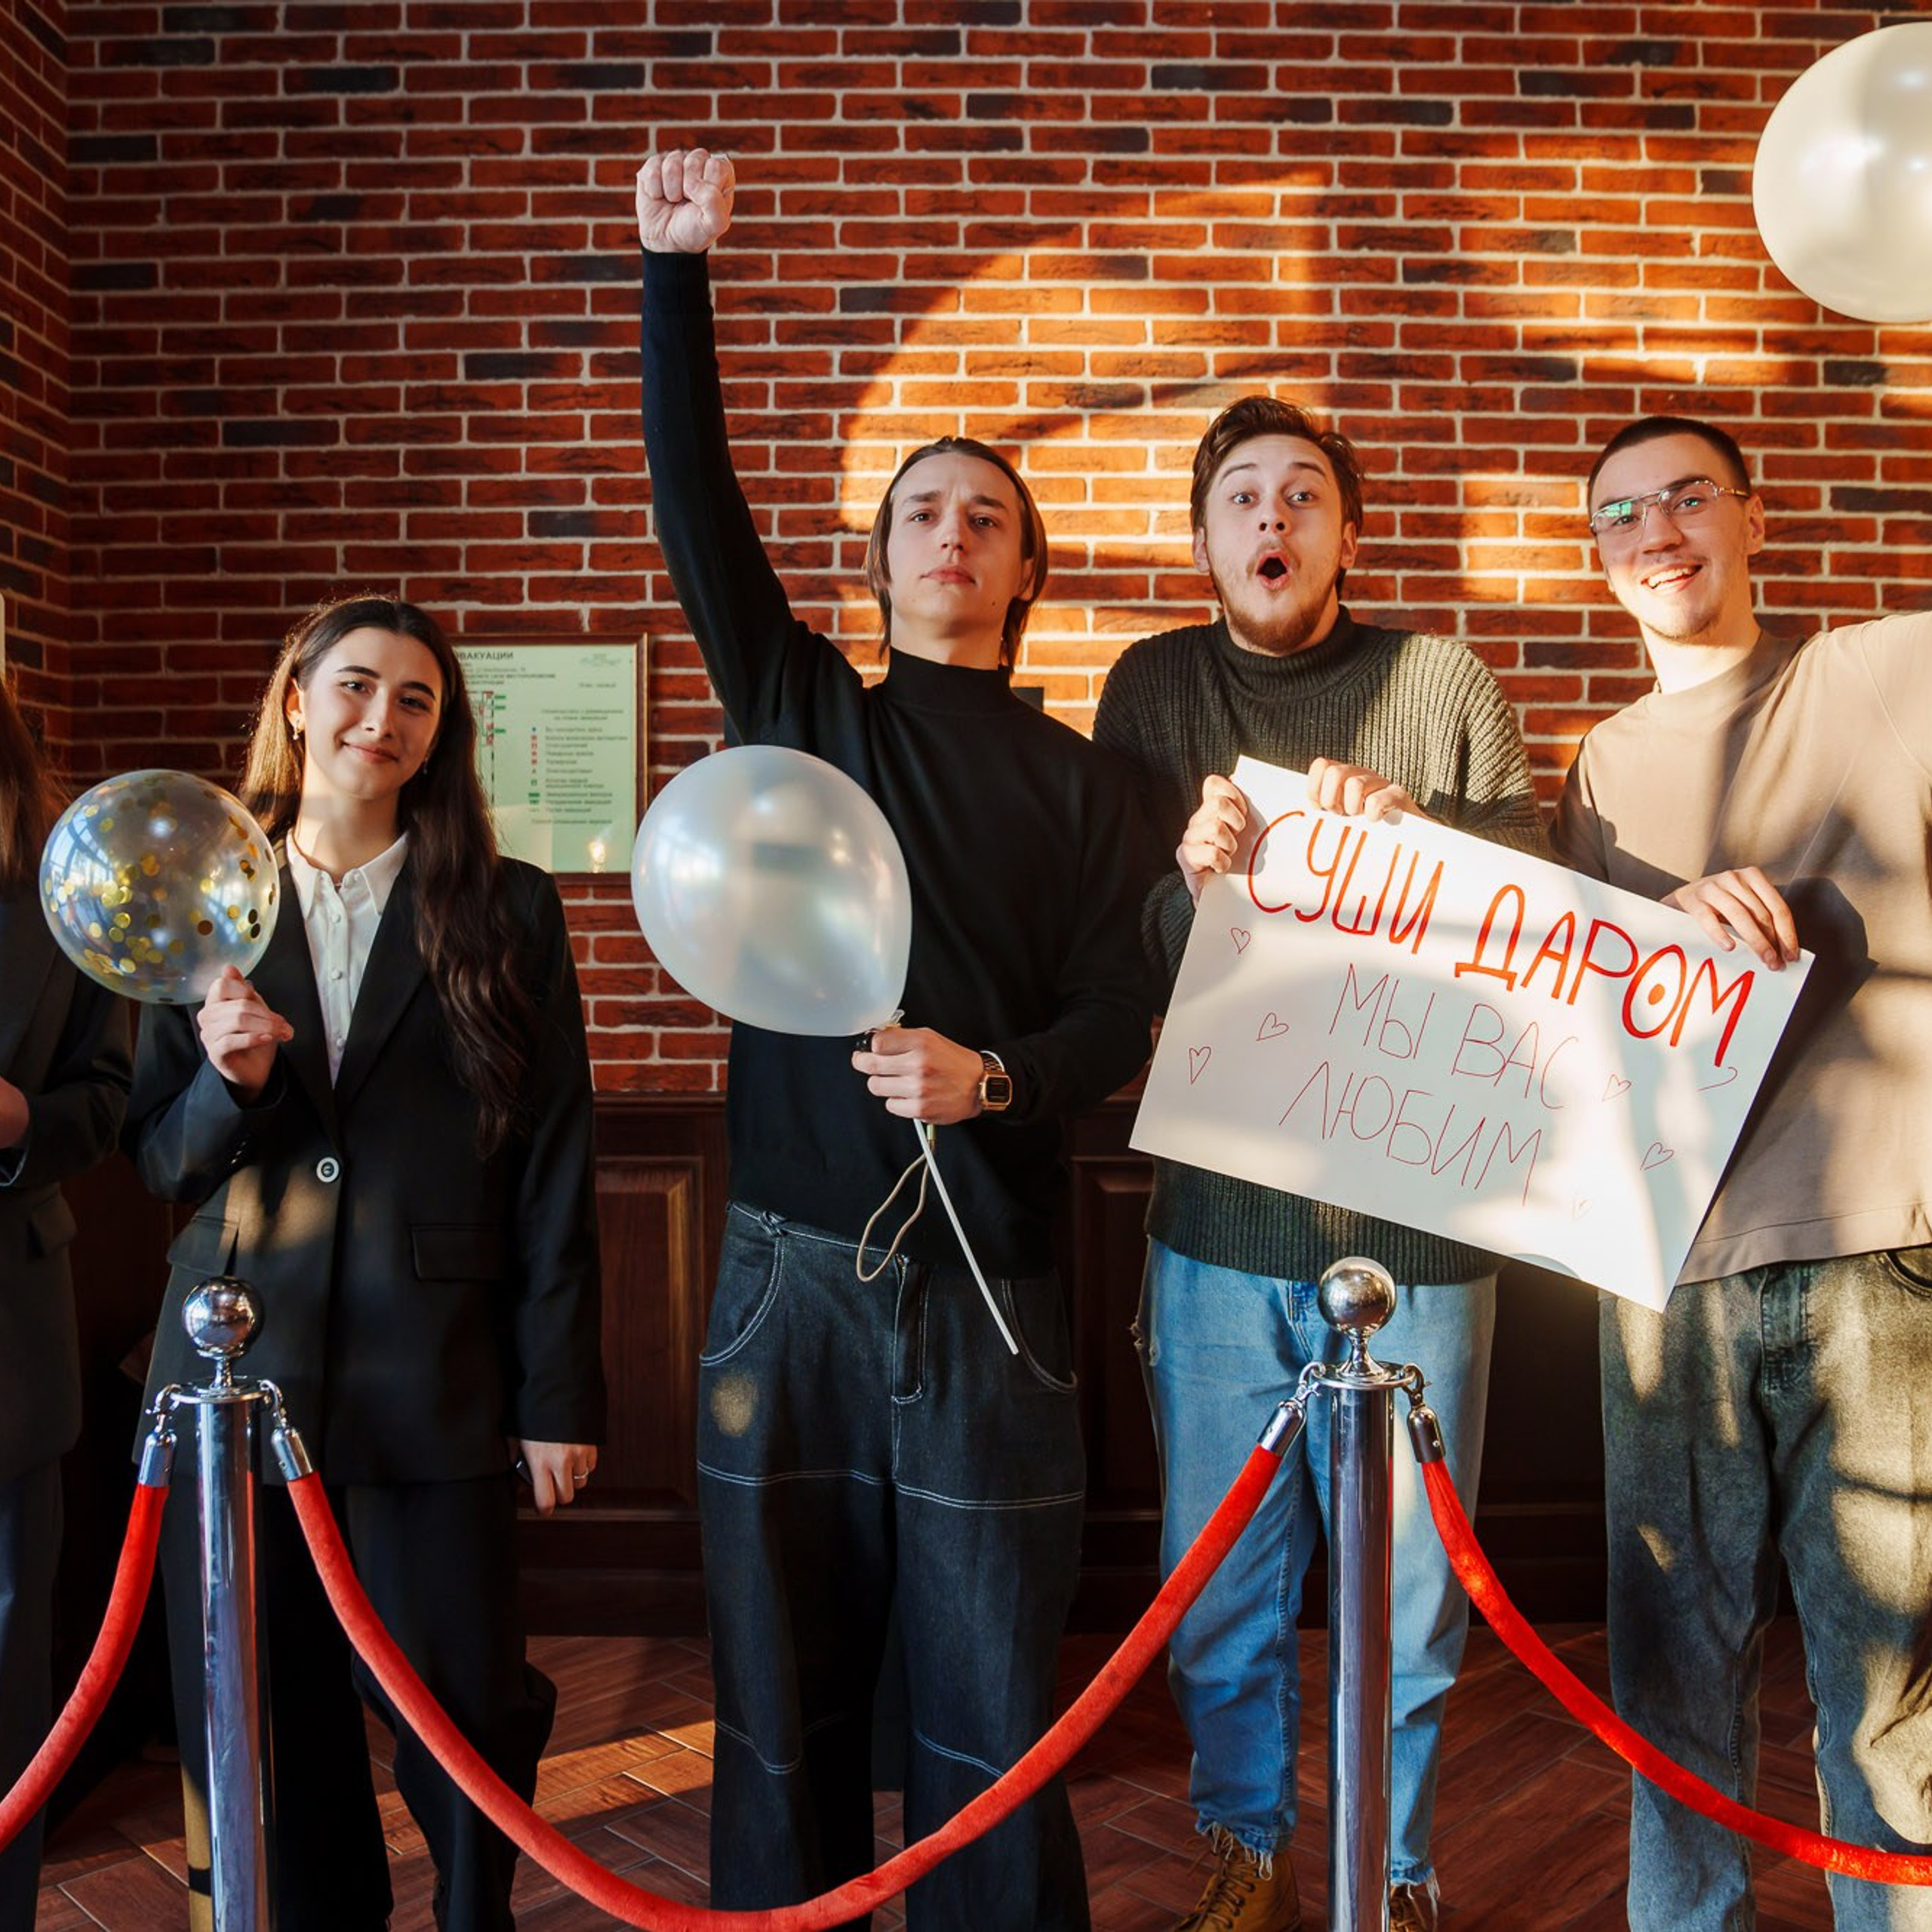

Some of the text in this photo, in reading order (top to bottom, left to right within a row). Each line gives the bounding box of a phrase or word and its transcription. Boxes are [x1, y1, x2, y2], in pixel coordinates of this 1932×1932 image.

[1247, 810, 1755, 1068] СУШИ ДАРОМ
[1329, 963, 1580, 1109] МЫ ВАС
[1278, 1060, 1543, 1206] ЛЮБИМ
